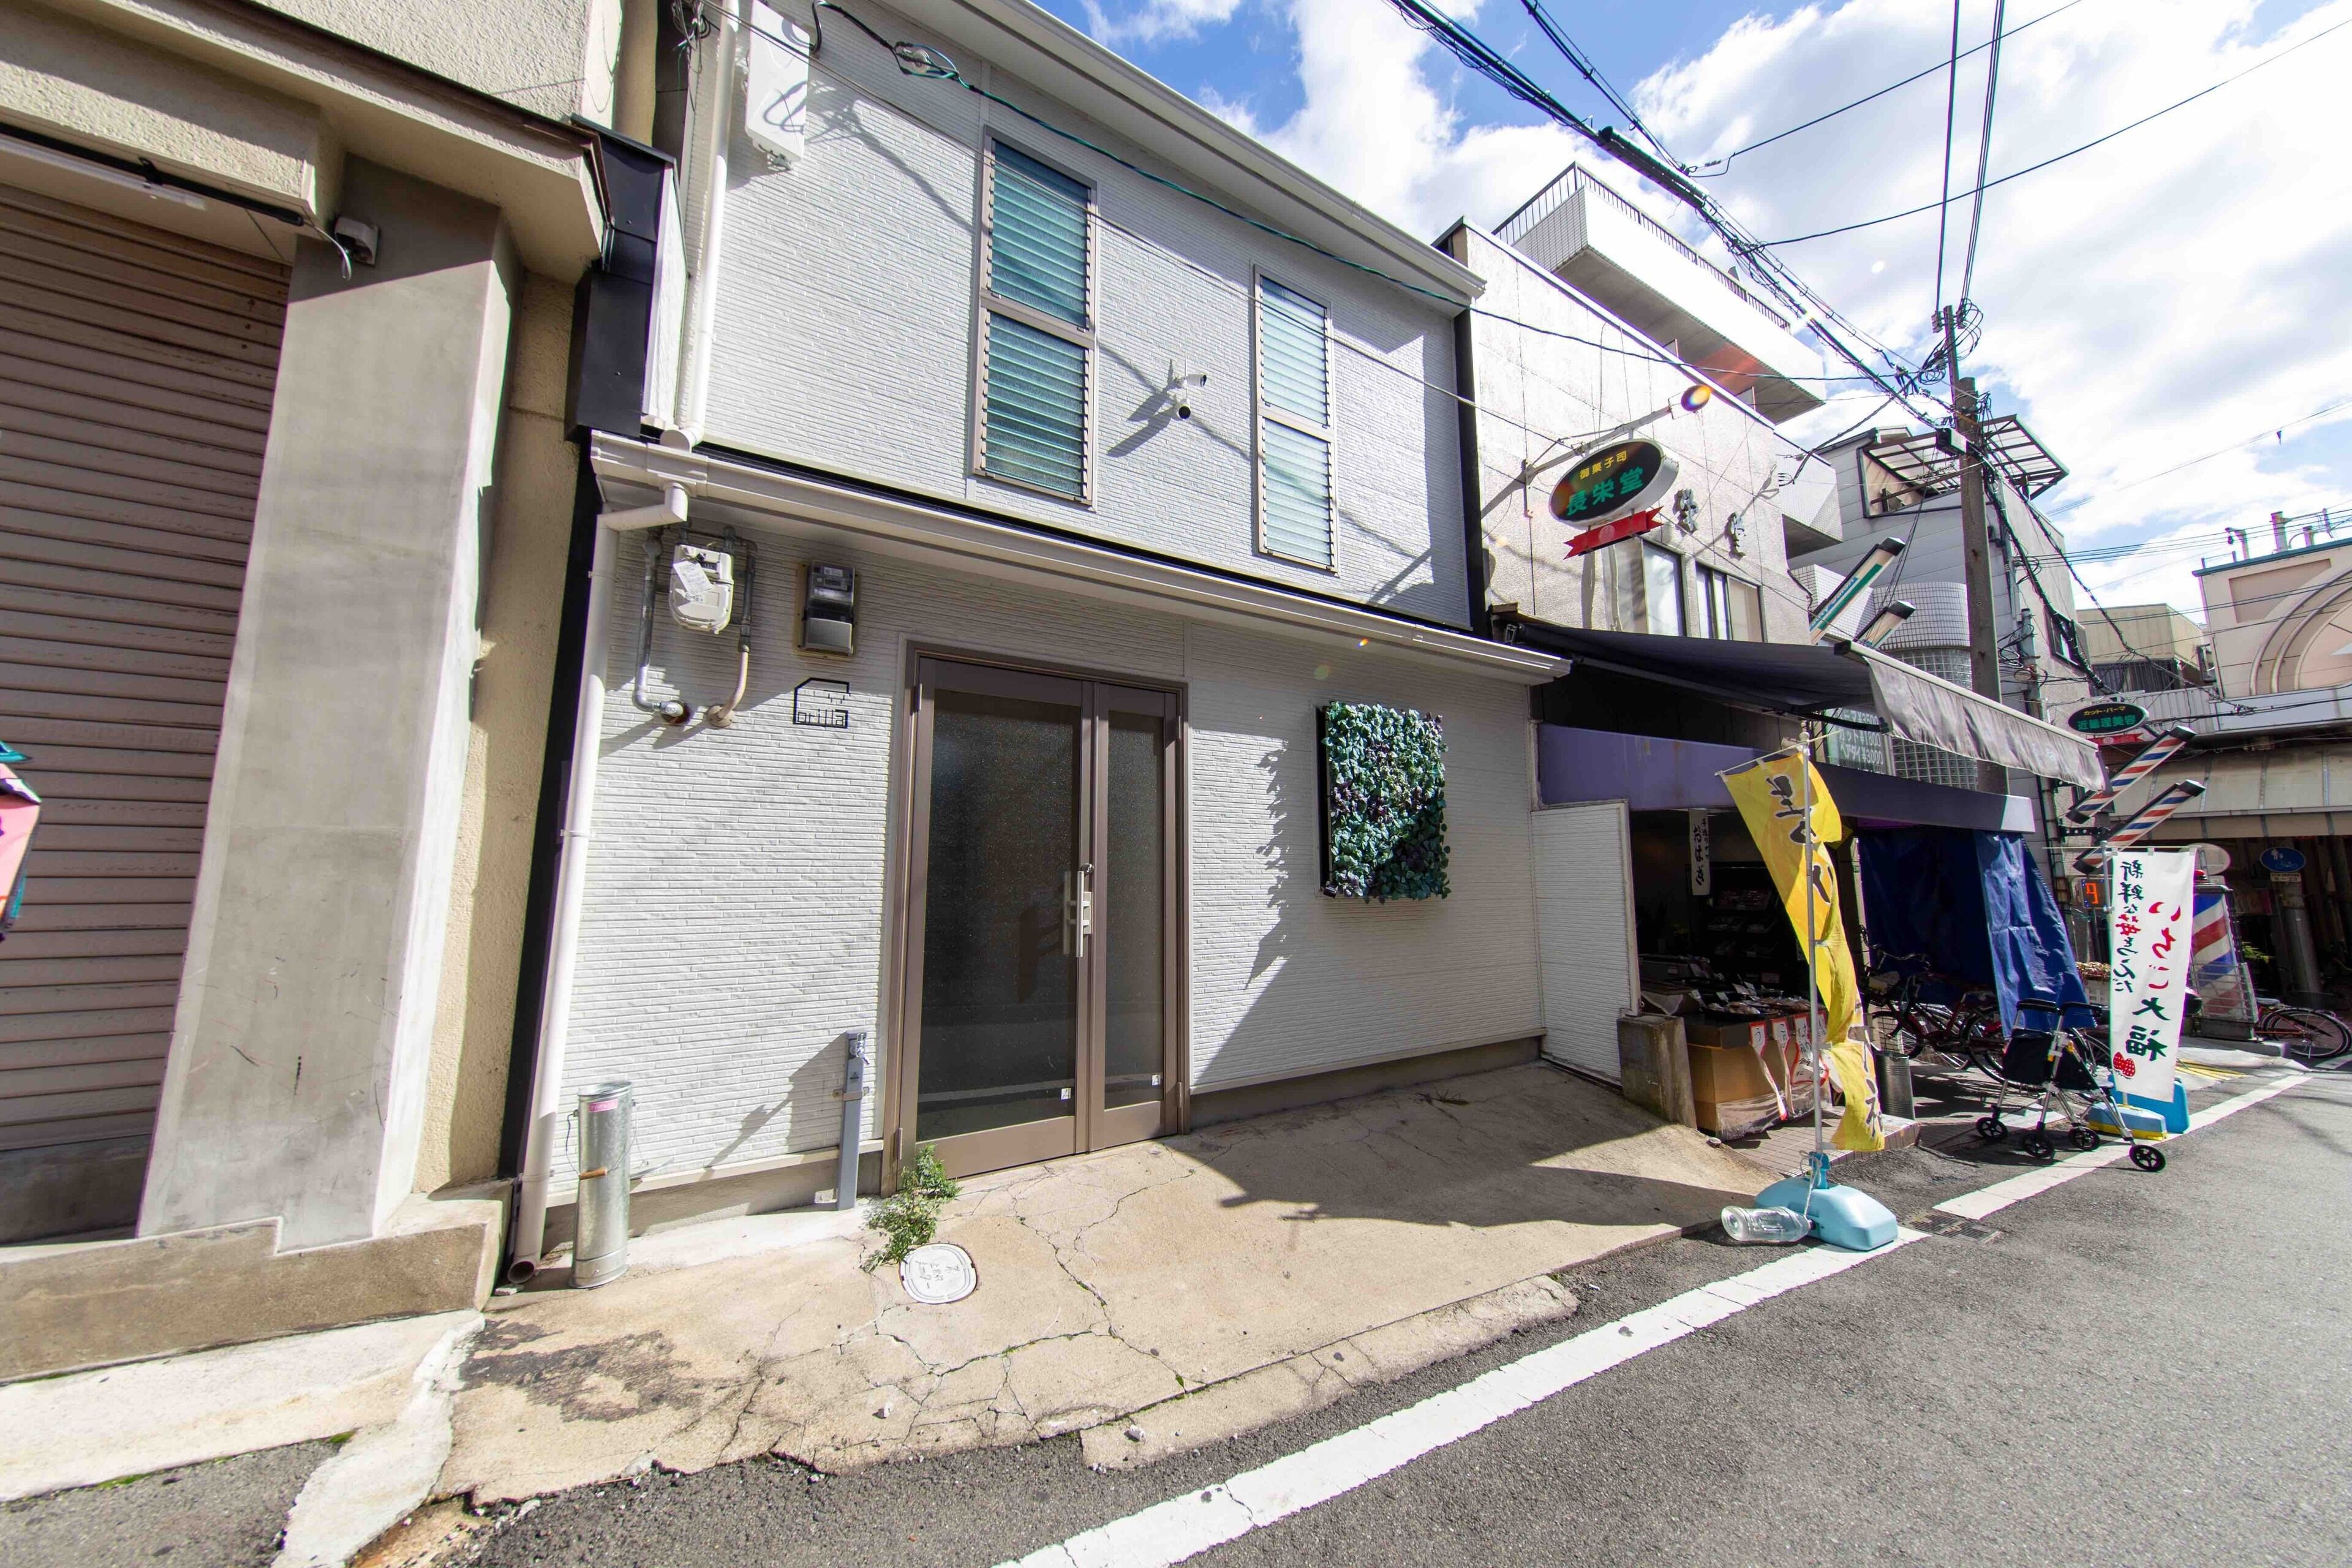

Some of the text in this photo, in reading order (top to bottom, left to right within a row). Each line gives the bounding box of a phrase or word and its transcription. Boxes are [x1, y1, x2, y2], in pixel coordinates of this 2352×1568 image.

[1580, 451, 1626, 480] 御菓子司
[1566, 466, 1644, 516] 長栄堂
